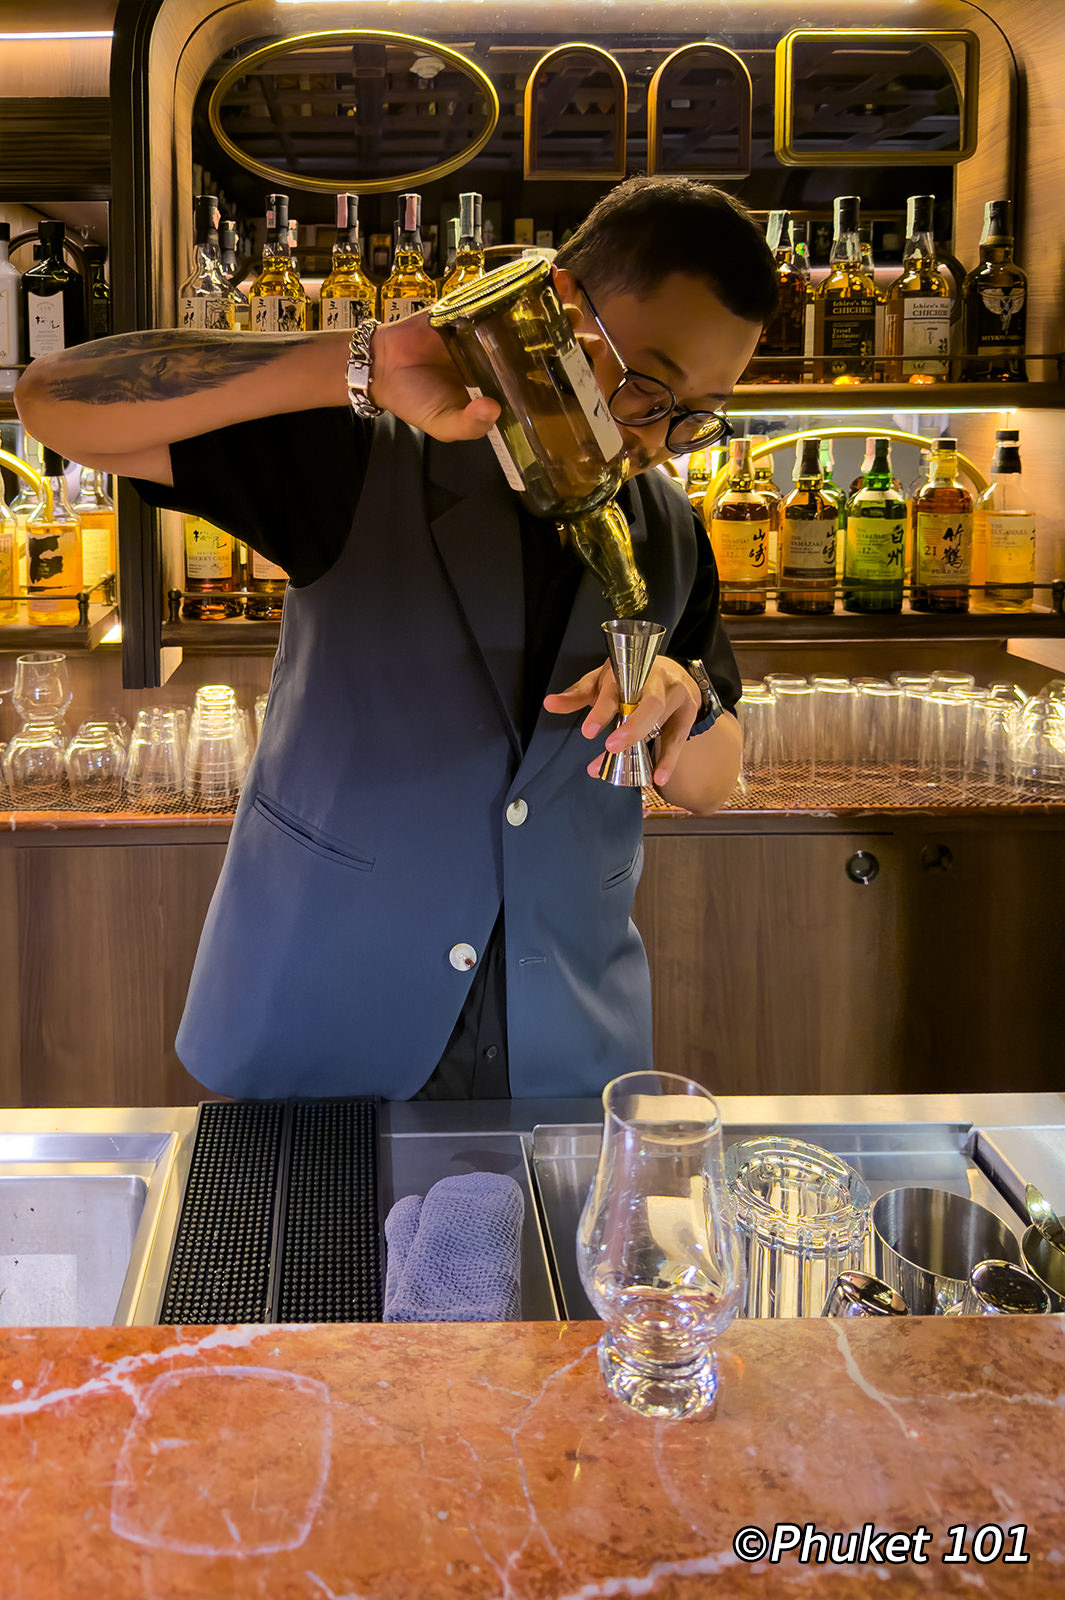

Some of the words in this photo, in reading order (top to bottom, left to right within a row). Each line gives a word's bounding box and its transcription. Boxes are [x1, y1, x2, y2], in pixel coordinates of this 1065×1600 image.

[748, 528, 767, 568] 山崎
[862, 546, 871, 555] 12
[887, 523, 904, 569] 白州
[924, 545, 937, 557] 21
[941, 523, 964, 569] 竹鶴
